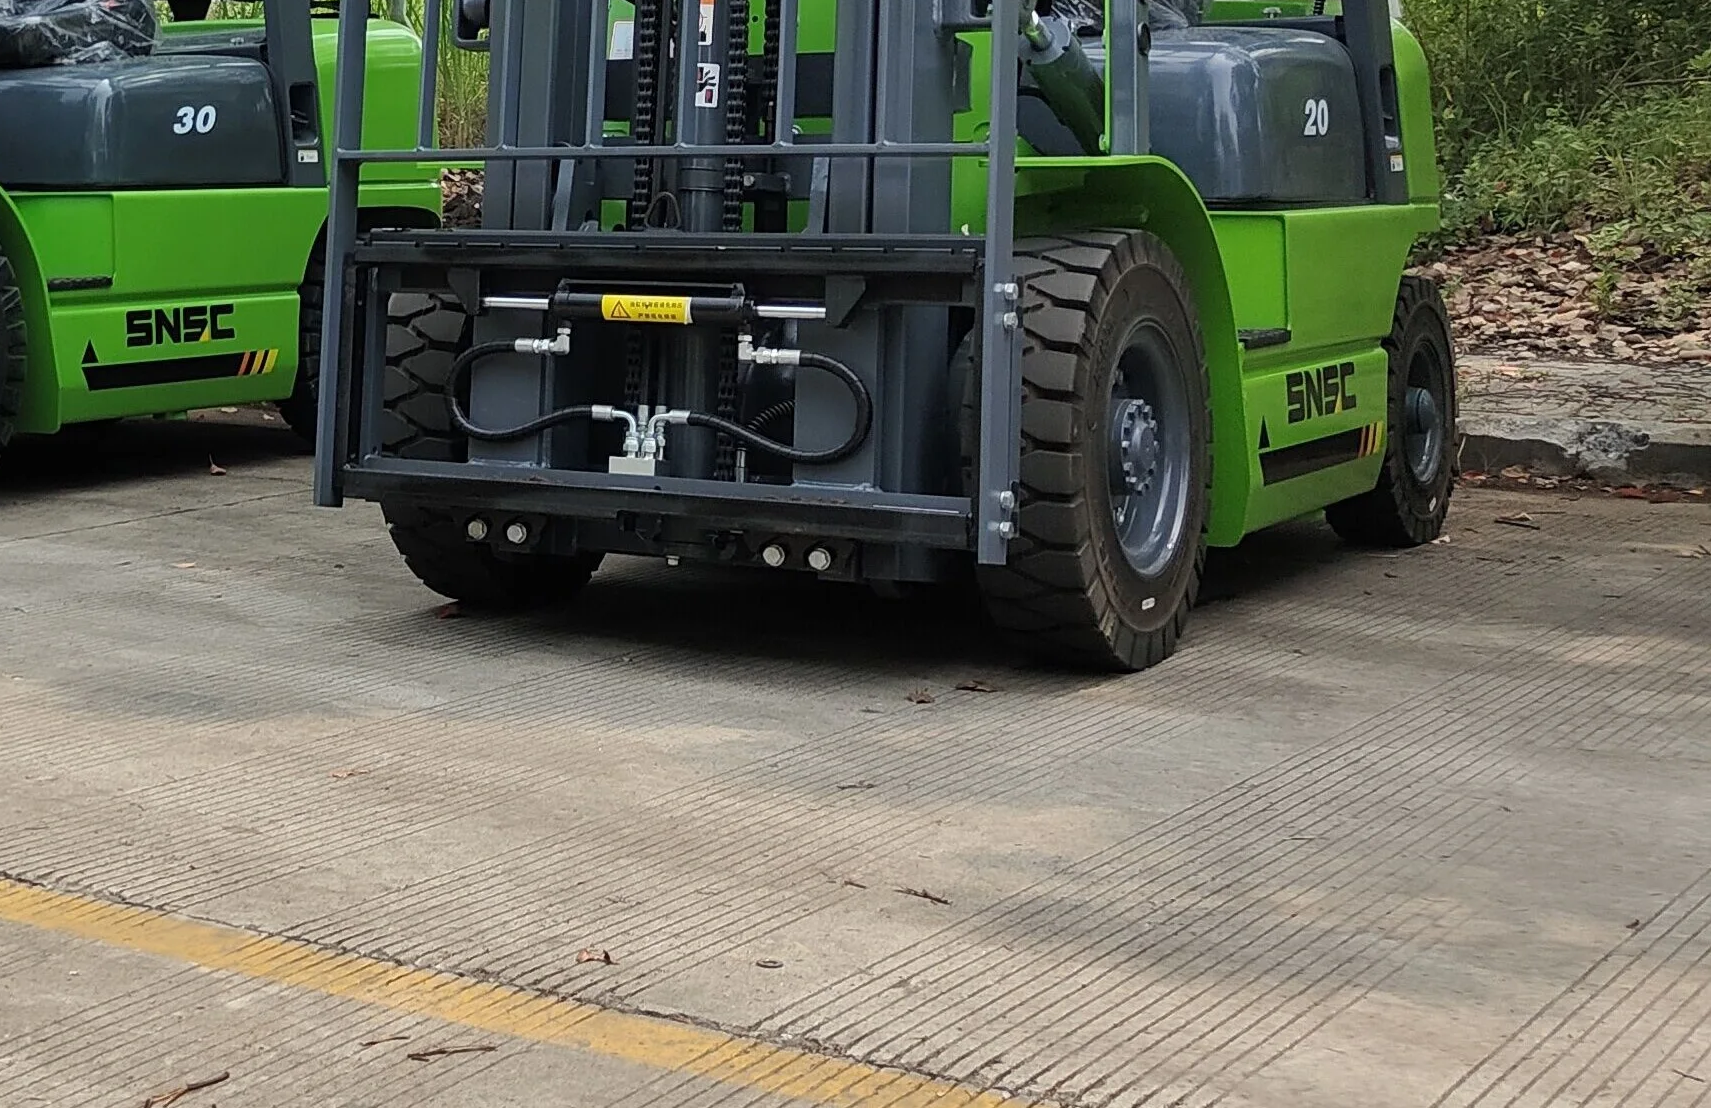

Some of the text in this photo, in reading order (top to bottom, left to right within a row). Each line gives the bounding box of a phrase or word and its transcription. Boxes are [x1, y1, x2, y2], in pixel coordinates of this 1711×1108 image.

[173, 105, 216, 134] 30
[1303, 98, 1329, 136] 20
[125, 303, 236, 348] SNSC
[1285, 361, 1357, 425] SNSC
